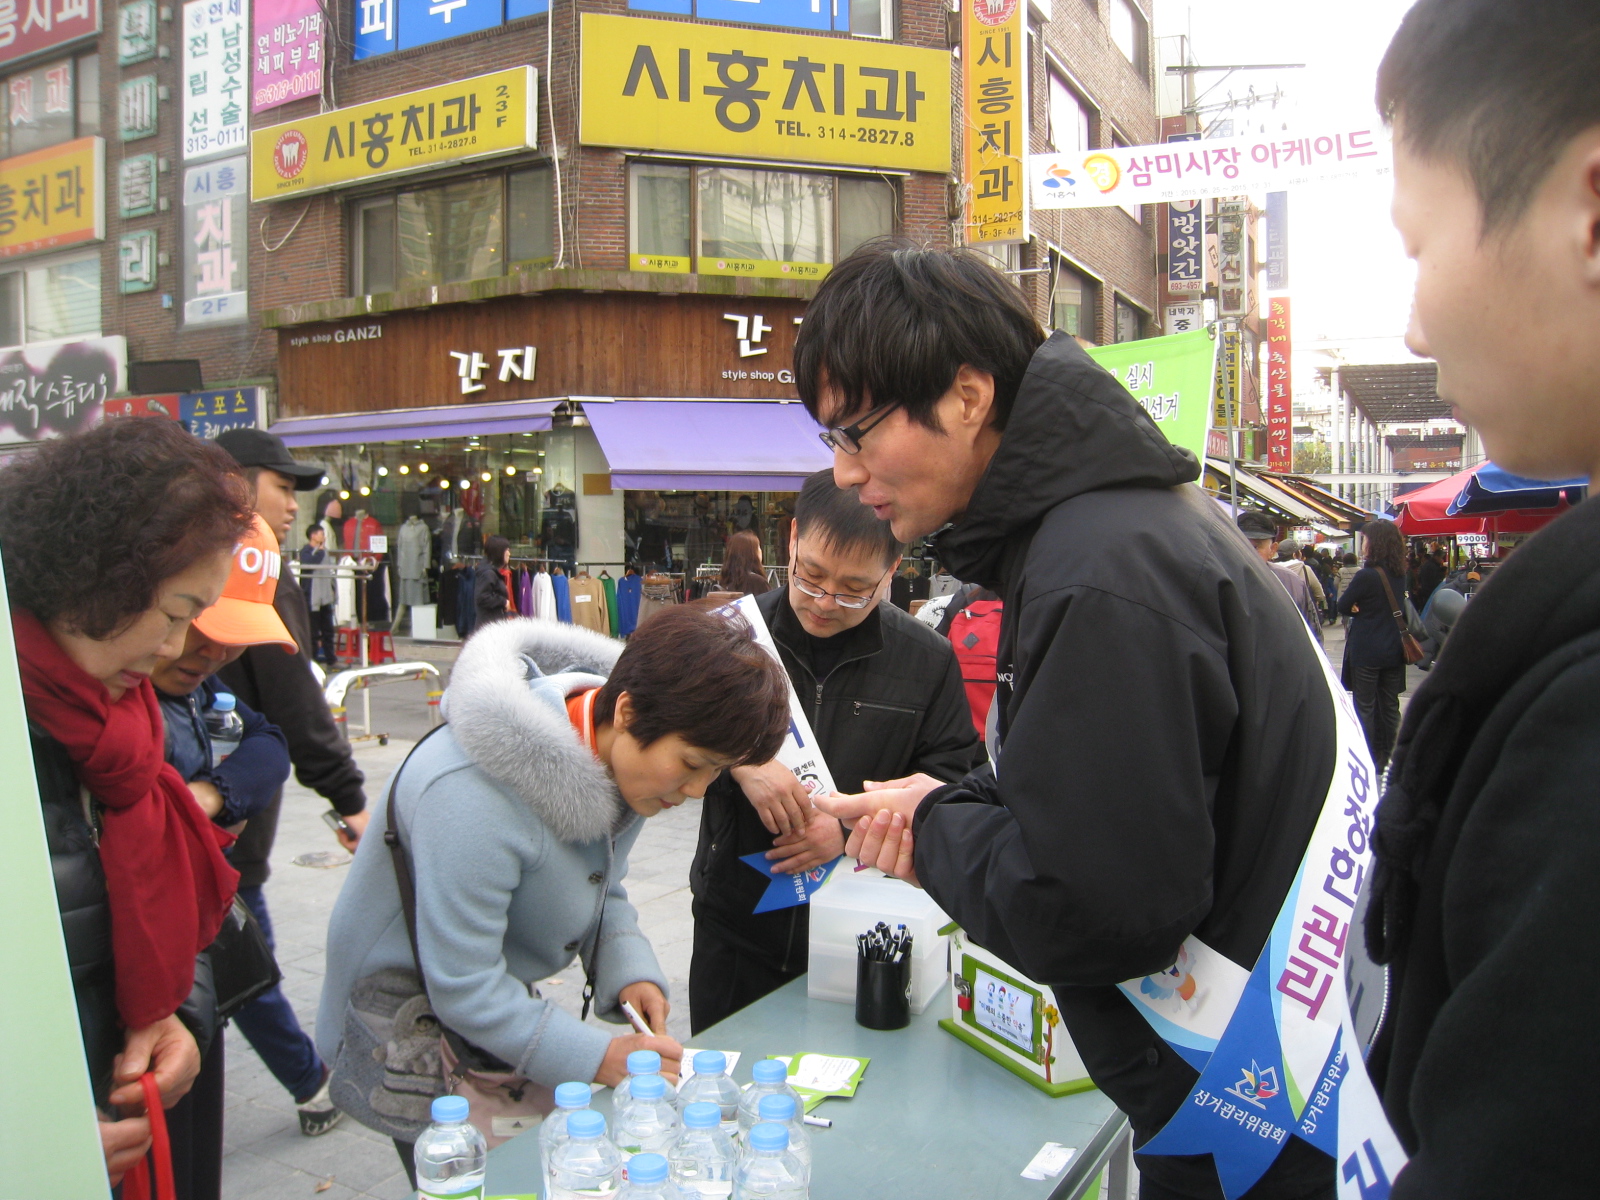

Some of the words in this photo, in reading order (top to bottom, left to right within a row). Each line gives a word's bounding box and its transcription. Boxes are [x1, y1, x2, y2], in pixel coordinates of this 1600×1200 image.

[274, 12, 322, 47] 비뇨기과
[273, 41, 321, 74] 피부과
[189, 32, 209, 135] 전립선
[220, 23, 243, 127] 남성수술
[265, 69, 321, 102] 313-0111
[621, 44, 926, 133] 시흥치과
[323, 93, 482, 169] 시흥치과
[775, 119, 811, 138] TEL.
[817, 126, 915, 147] 314-2827.8
[977, 32, 1014, 202] 시흥치과
[186, 125, 246, 154] 313-0111
[408, 146, 426, 157] TEL.
[1126, 146, 1242, 188] 삼미시장
[1250, 129, 1378, 170] 아케이드
[192, 166, 237, 194] 시흥
[194, 197, 238, 295] 치과
[1170, 213, 1200, 280] 방앗간
[201, 298, 229, 316] 2F
[290, 336, 309, 347] style
[312, 333, 332, 343] shop
[334, 324, 382, 343] GANZI
[450, 345, 537, 395] 간지
[721, 370, 748, 382] style
[750, 370, 775, 382] shop
[1126, 362, 1153, 390] 실시
[193, 390, 248, 417] 스포츠
[1456, 534, 1487, 544] 99000
[1276, 903, 1350, 1021] 관리
[1192, 1088, 1287, 1145] 선거관리위원회
